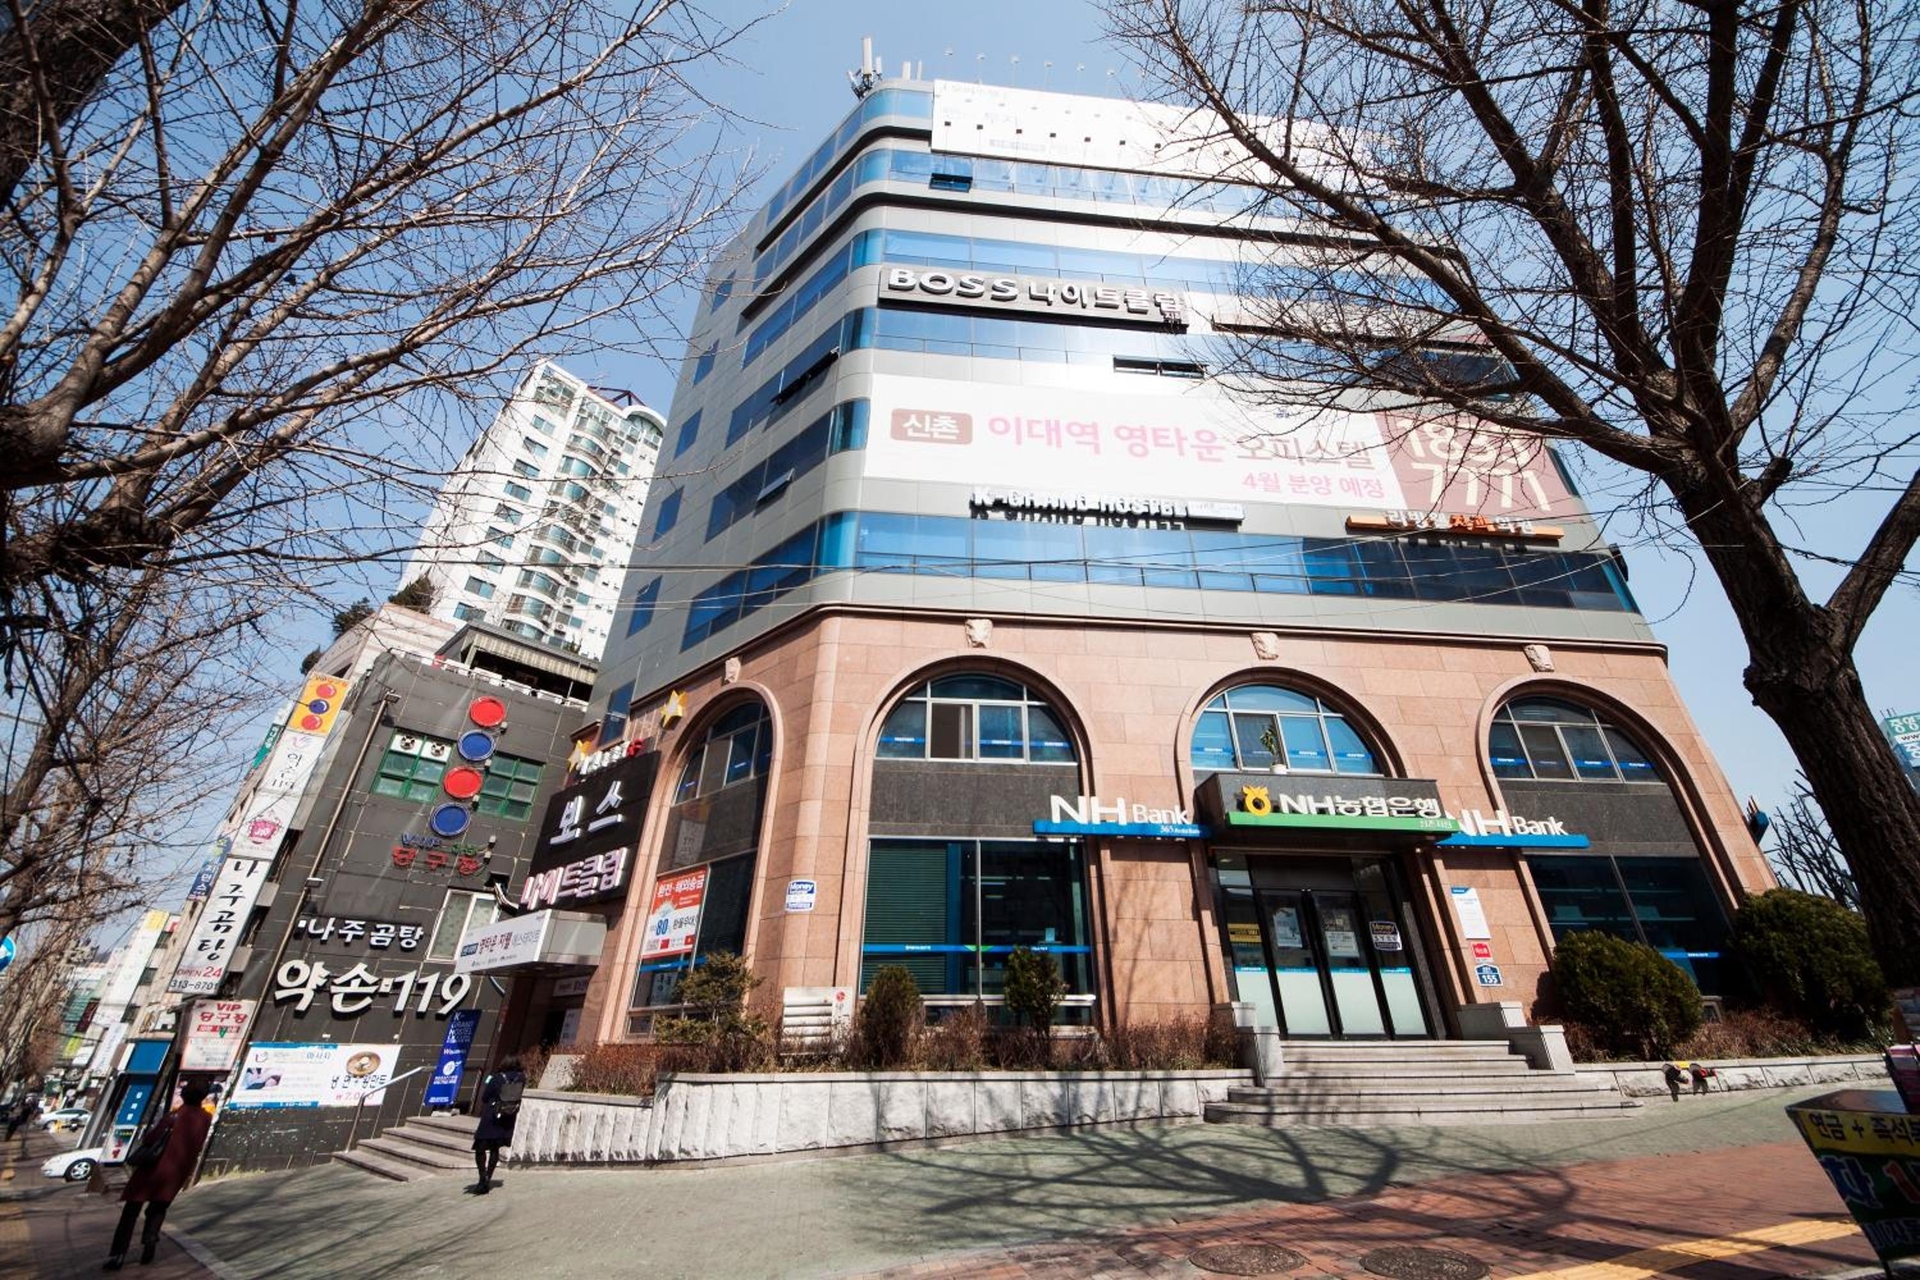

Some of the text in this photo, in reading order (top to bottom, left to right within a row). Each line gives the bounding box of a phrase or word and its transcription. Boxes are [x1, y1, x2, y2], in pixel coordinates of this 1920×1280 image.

[887, 268, 1184, 319] BOSS 나이트클럽
[902, 414, 961, 440] 신촌
[988, 415, 1376, 470] 이대역 영타운 오피스텔
[1242, 472, 1386, 499] 4월 분양 예정
[1411, 462, 1552, 512] 7771
[549, 779, 625, 846] 보스
[1050, 794, 1193, 826] NH Bank
[1279, 793, 1441, 819] NH농협은행
[1512, 815, 1569, 836] Bank
[520, 847, 628, 910] 나이트클럽
[197, 859, 259, 961] 나주곰탕
[306, 917, 425, 951] 나주곰탕
[656, 918, 669, 936] 80
[176, 966, 223, 978] OPEN 24
[1481, 974, 1499, 984] 155
[199, 1011, 248, 1025] 당구장
[1808, 1112, 1847, 1142] 연금
